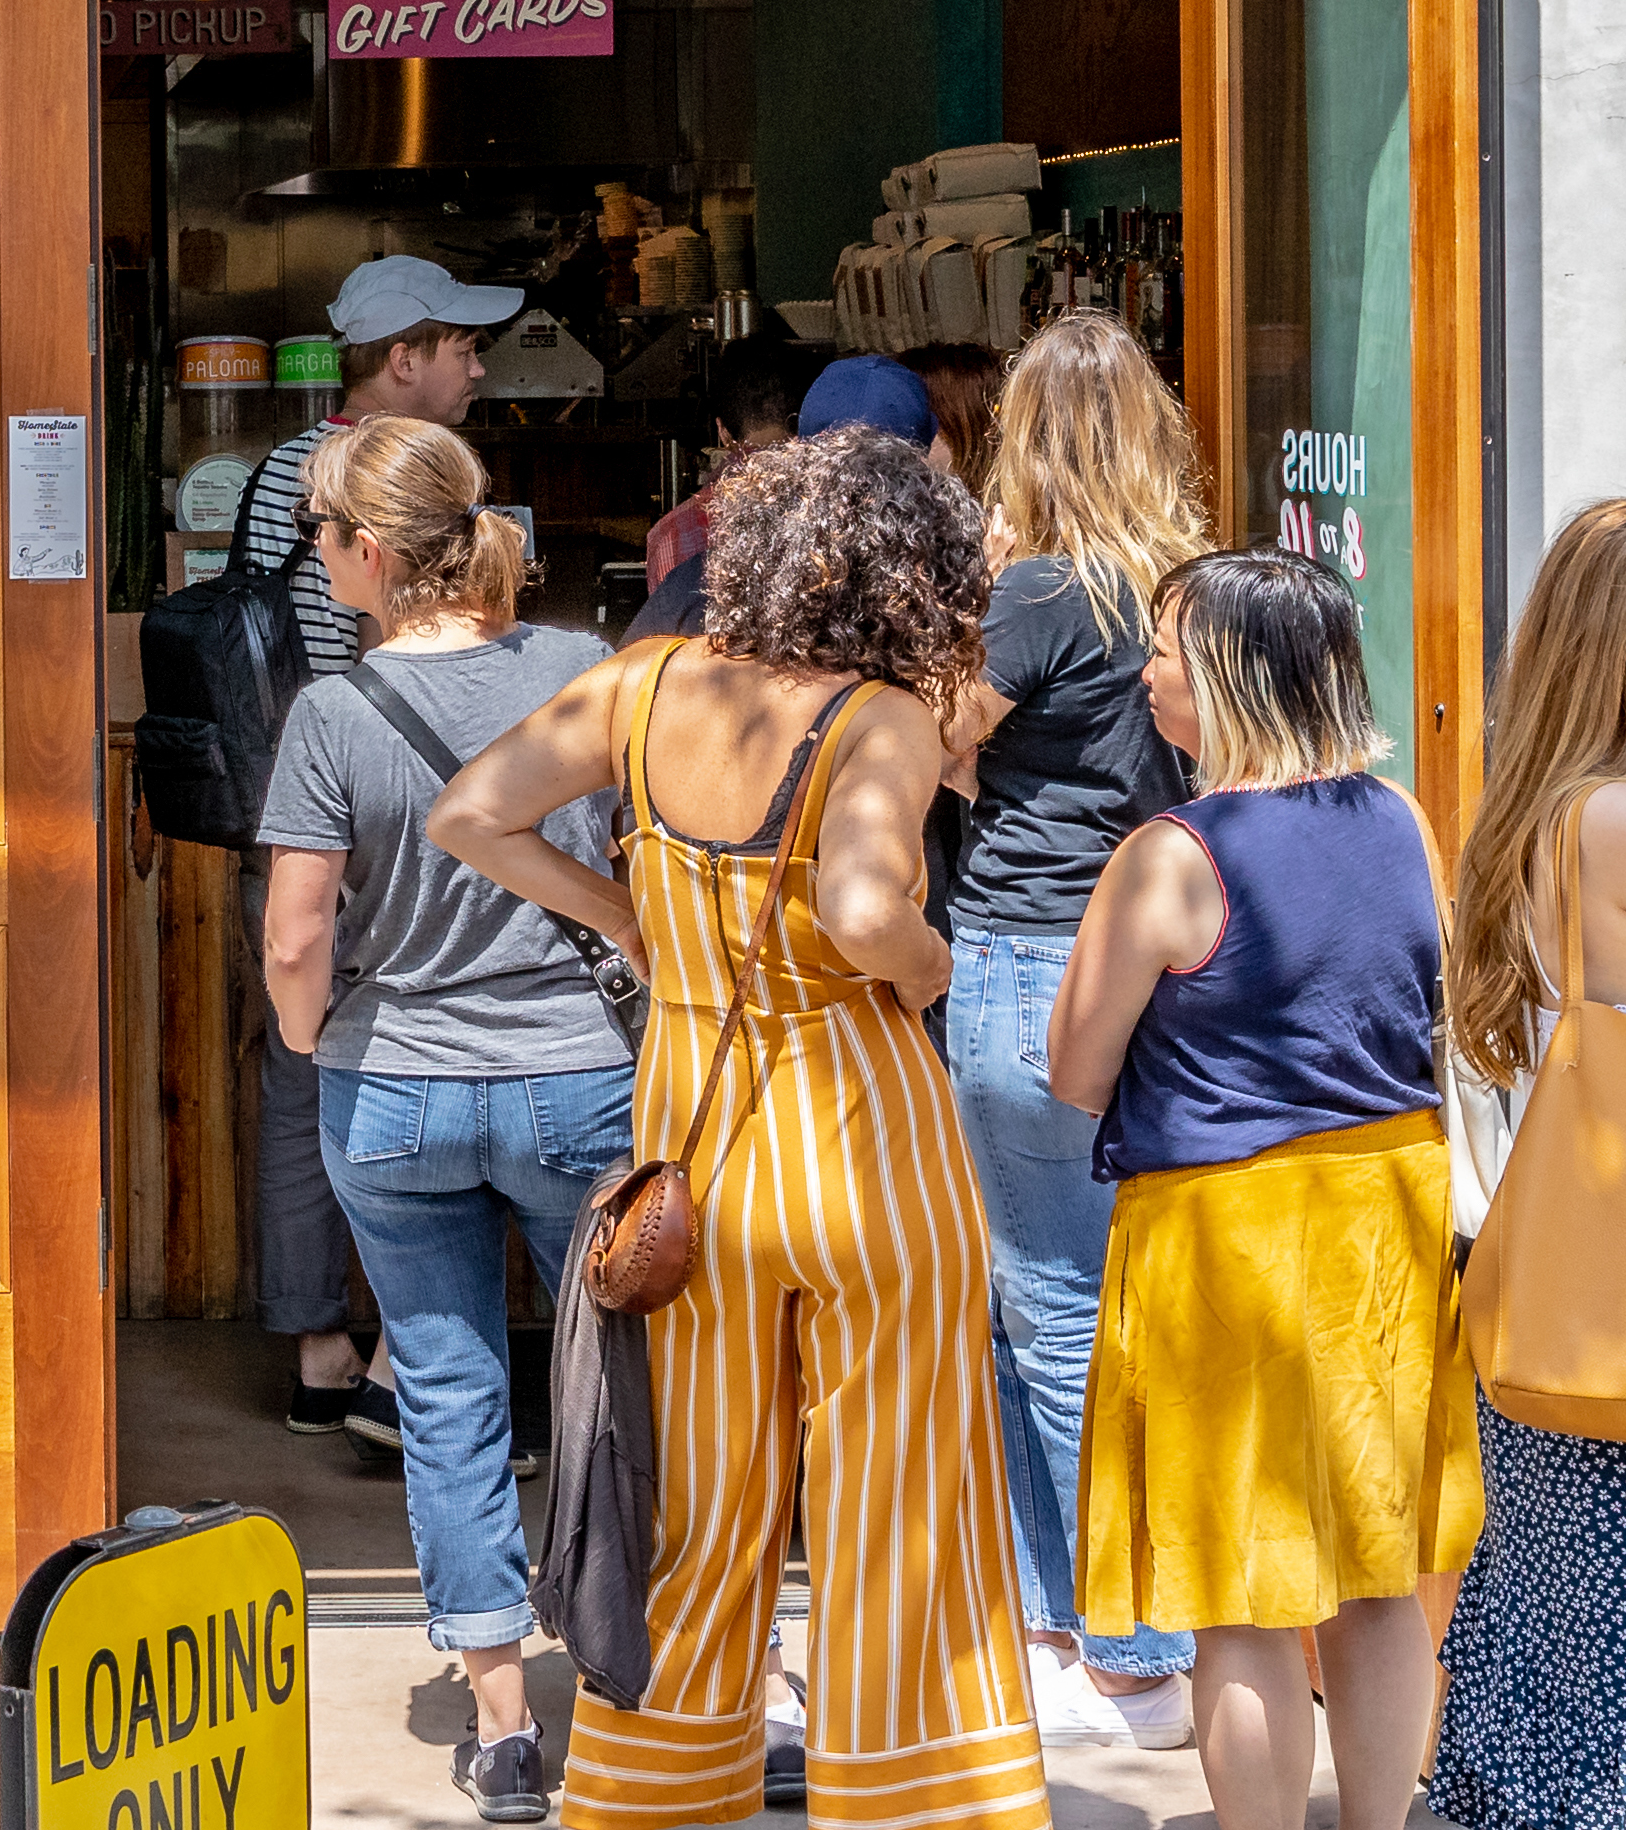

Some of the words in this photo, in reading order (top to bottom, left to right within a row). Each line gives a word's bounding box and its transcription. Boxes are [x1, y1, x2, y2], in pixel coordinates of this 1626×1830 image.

[134, 7, 267, 45] PICKUP
[336, 1, 447, 55] GIFT
[186, 358, 261, 378] PALOMA
[18, 420, 78, 432] HomeState
[48, 1589, 296, 1785] LOADING
